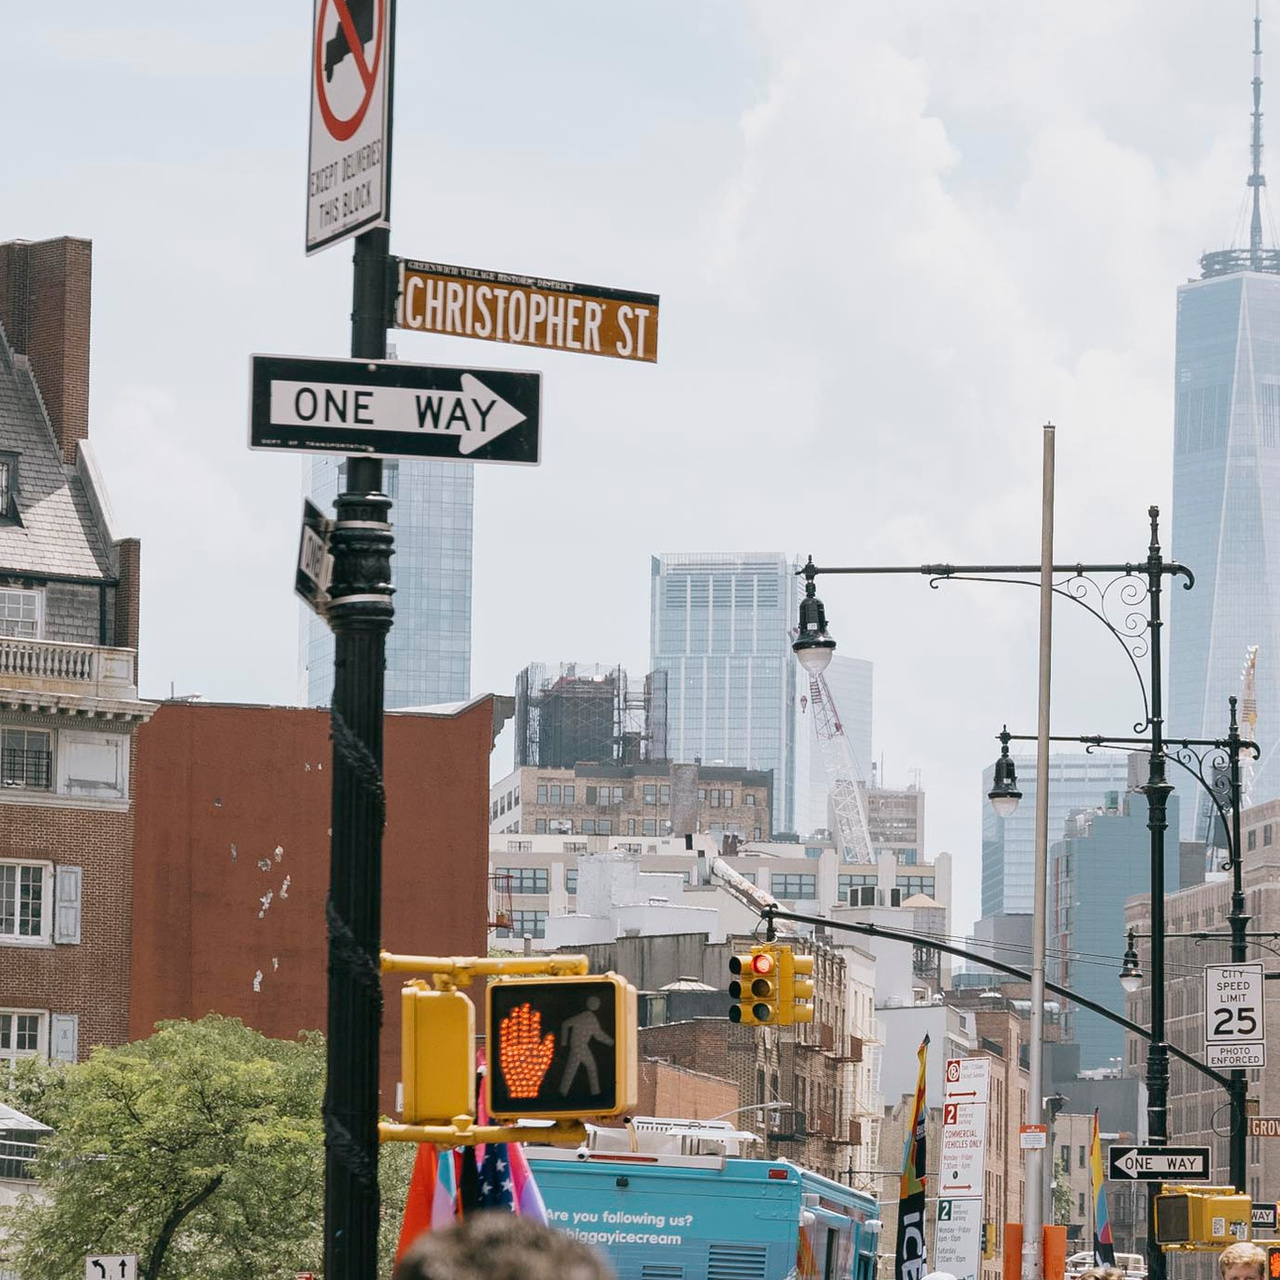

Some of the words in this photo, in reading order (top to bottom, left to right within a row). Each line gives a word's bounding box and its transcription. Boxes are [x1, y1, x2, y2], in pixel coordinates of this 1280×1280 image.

[311, 161, 338, 197] EXCEPT
[342, 139, 381, 182] DELIVERIES
[319, 197, 339, 229] THIS
[343, 181, 372, 217] BLOCK
[459, 267, 497, 281] VILLAGE
[537, 278, 575, 291] DISTRICT
[405, 276, 601, 352] CHRISTOPHER
[616, 305, 649, 358] ST
[295, 387, 374, 425] ONE
[415, 394, 498, 432] WAY
[1221, 970, 1244, 979] CITY
[1217, 982, 1250, 991] SPEED
[1220, 994, 1247, 1003] LIMIT
[1213, 1007, 1257, 1035] 25
[1220, 1047, 1250, 1056] PHOTO
[1211, 1056, 1260, 1065] ENFORCED
[947, 1105, 955, 1124] 2
[945, 1130, 977, 1138] COMMERCIAL
[945, 1140, 968, 1149] VEHICLES
[969, 1139, 982, 1148] ONLY
[1125, 1157, 1153, 1170] ONE
[1167, 1157, 1197, 1170] WAY
[941, 1202, 949, 1219] 2
[1252, 1211, 1272, 1221] WAY
[546, 1209, 569, 1221] Are
[573, 1212, 598, 1224] you
[602, 1211, 666, 1228] following
[669, 1214, 693, 1227] us?
